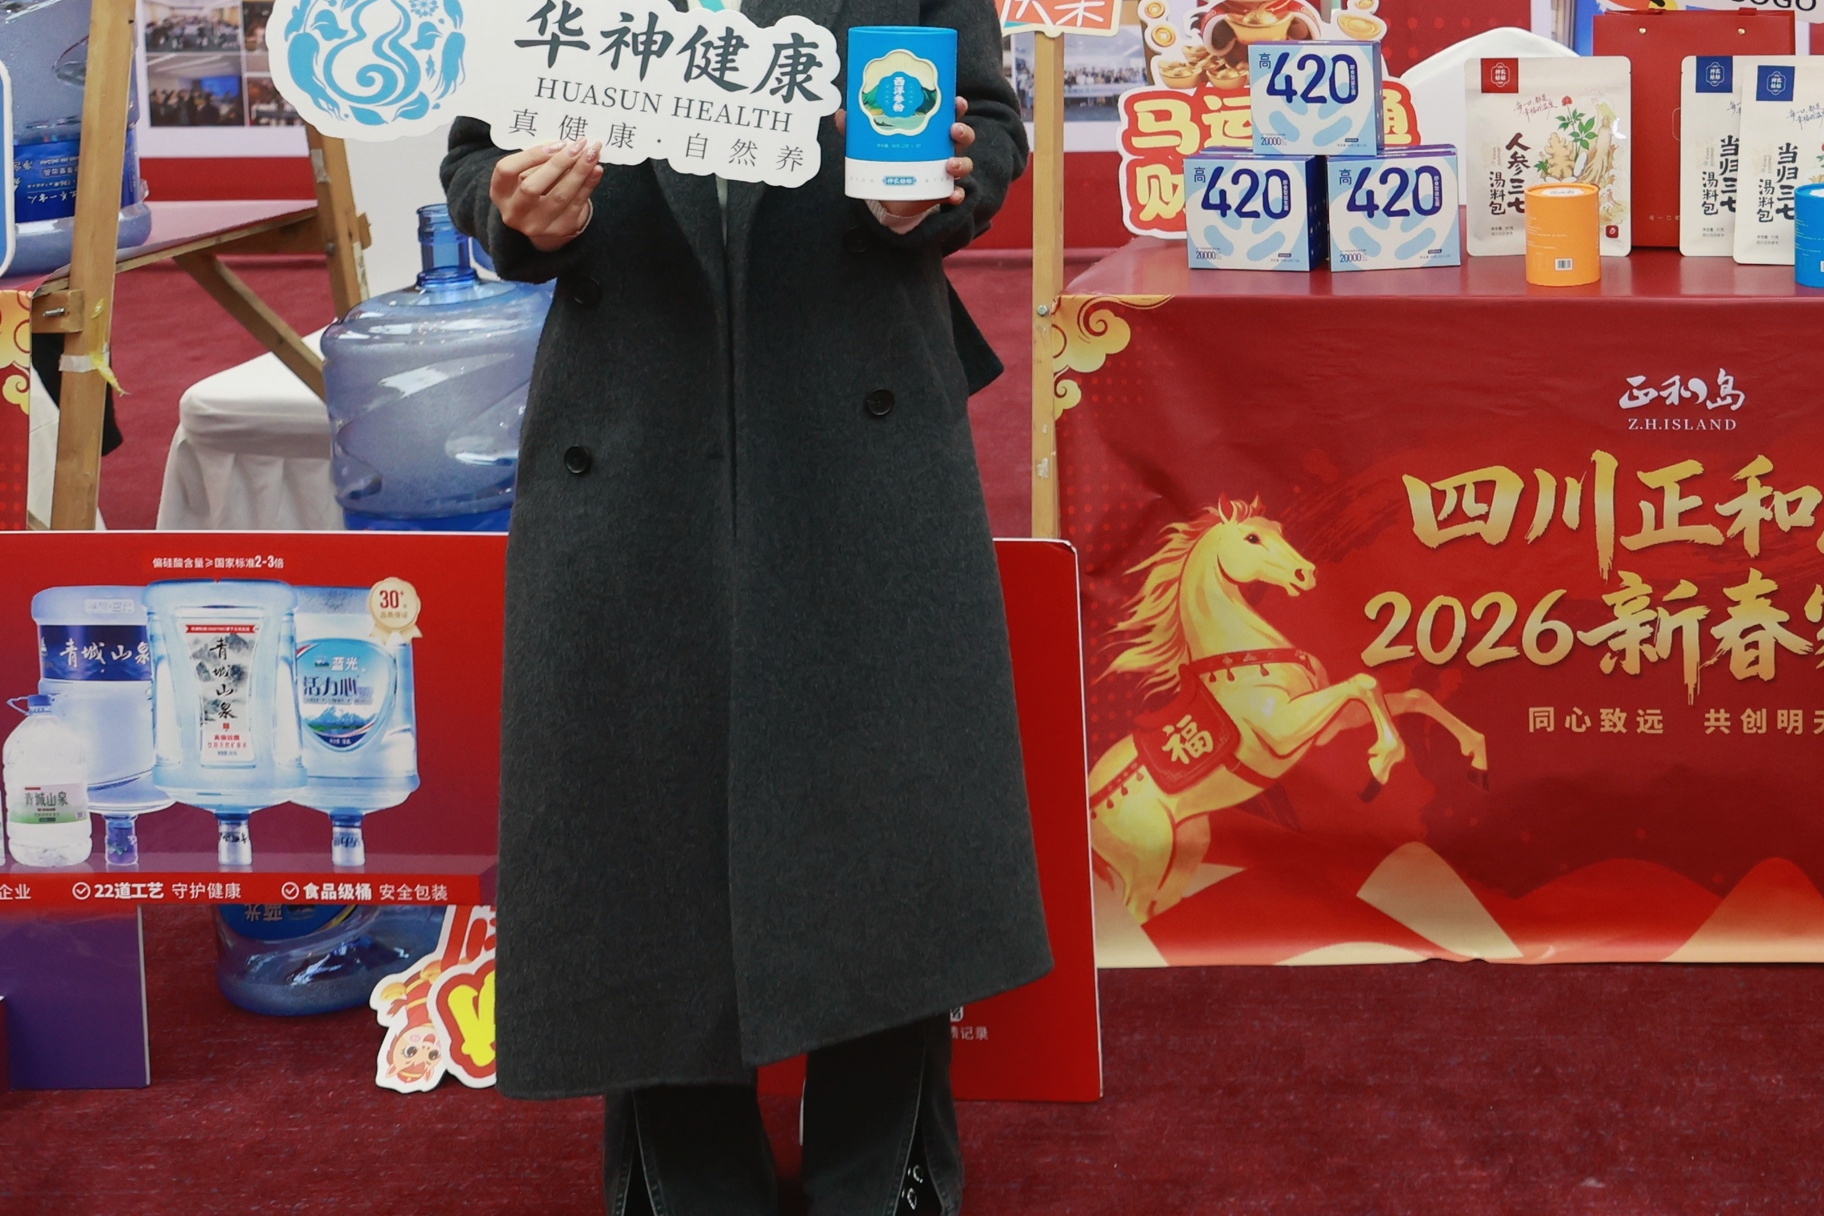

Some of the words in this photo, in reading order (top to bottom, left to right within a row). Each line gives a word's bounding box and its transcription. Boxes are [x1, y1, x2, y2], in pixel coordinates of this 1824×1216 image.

[1258, 52, 1272, 69] 高
[1266, 51, 1359, 105] 420
[534, 76, 661, 115] HUASUN
[671, 95, 794, 133] HEALTH
[1193, 167, 1207, 184] 高
[1201, 165, 1291, 220] 420
[1338, 168, 1352, 186] 高
[1346, 165, 1443, 219] 420
[1775, 142, 1799, 221] 当归三七
[1619, 367, 1746, 412] 正和岛
[1628, 417, 1737, 431] Z.H.ISLAND
[59, 637, 150, 669] 青城山泉
[209, 638, 238, 719] 青城山泉
[331, 656, 359, 672] 蓝光
[1161, 713, 1214, 765] 福
[1528, 706, 1665, 734] 同心致远
[94, 882, 164, 900] 22道工艺
[172, 883, 242, 900] 守护健康
[303, 882, 372, 901] 食品级桶
[379, 883, 448, 901] 安全包装
